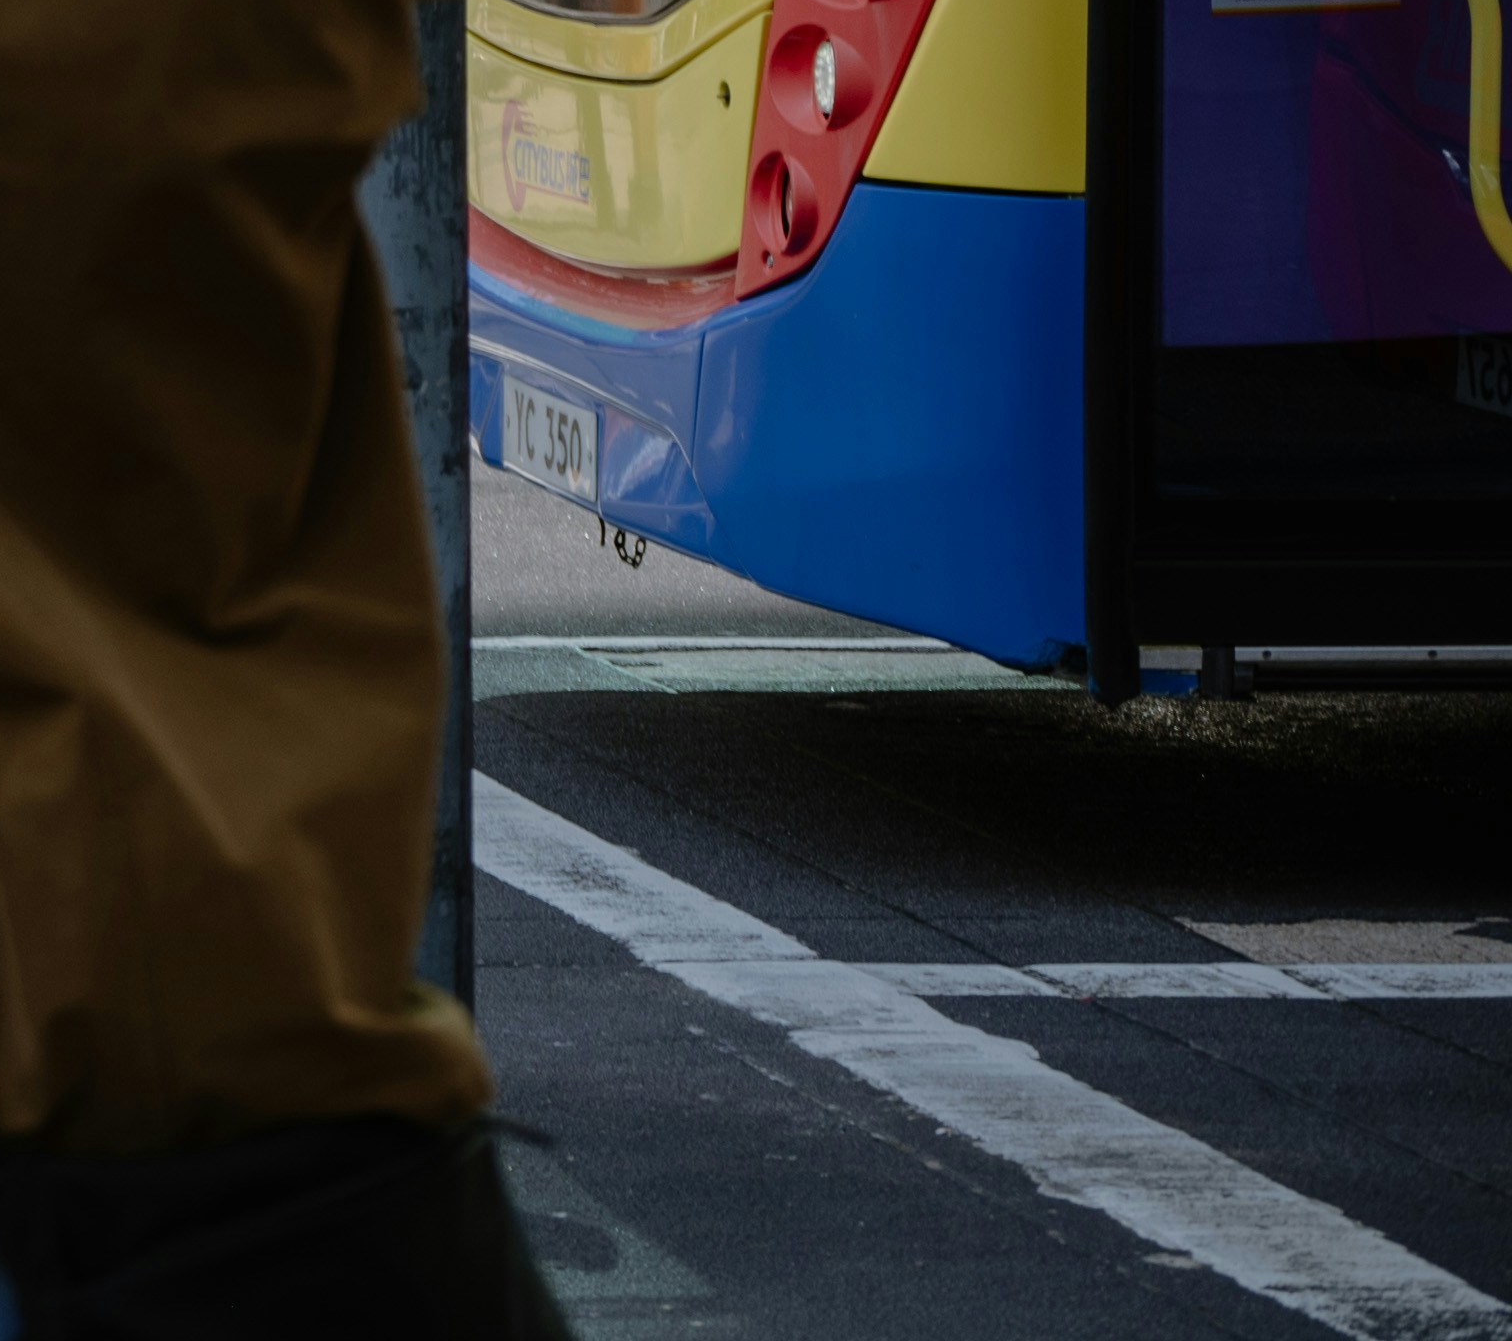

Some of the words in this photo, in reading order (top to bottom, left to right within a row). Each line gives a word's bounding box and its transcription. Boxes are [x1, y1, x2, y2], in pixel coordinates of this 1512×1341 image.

[514, 138, 565, 192] CITYBUS
[514, 388, 536, 462] YC
[543, 405, 582, 483] 350
